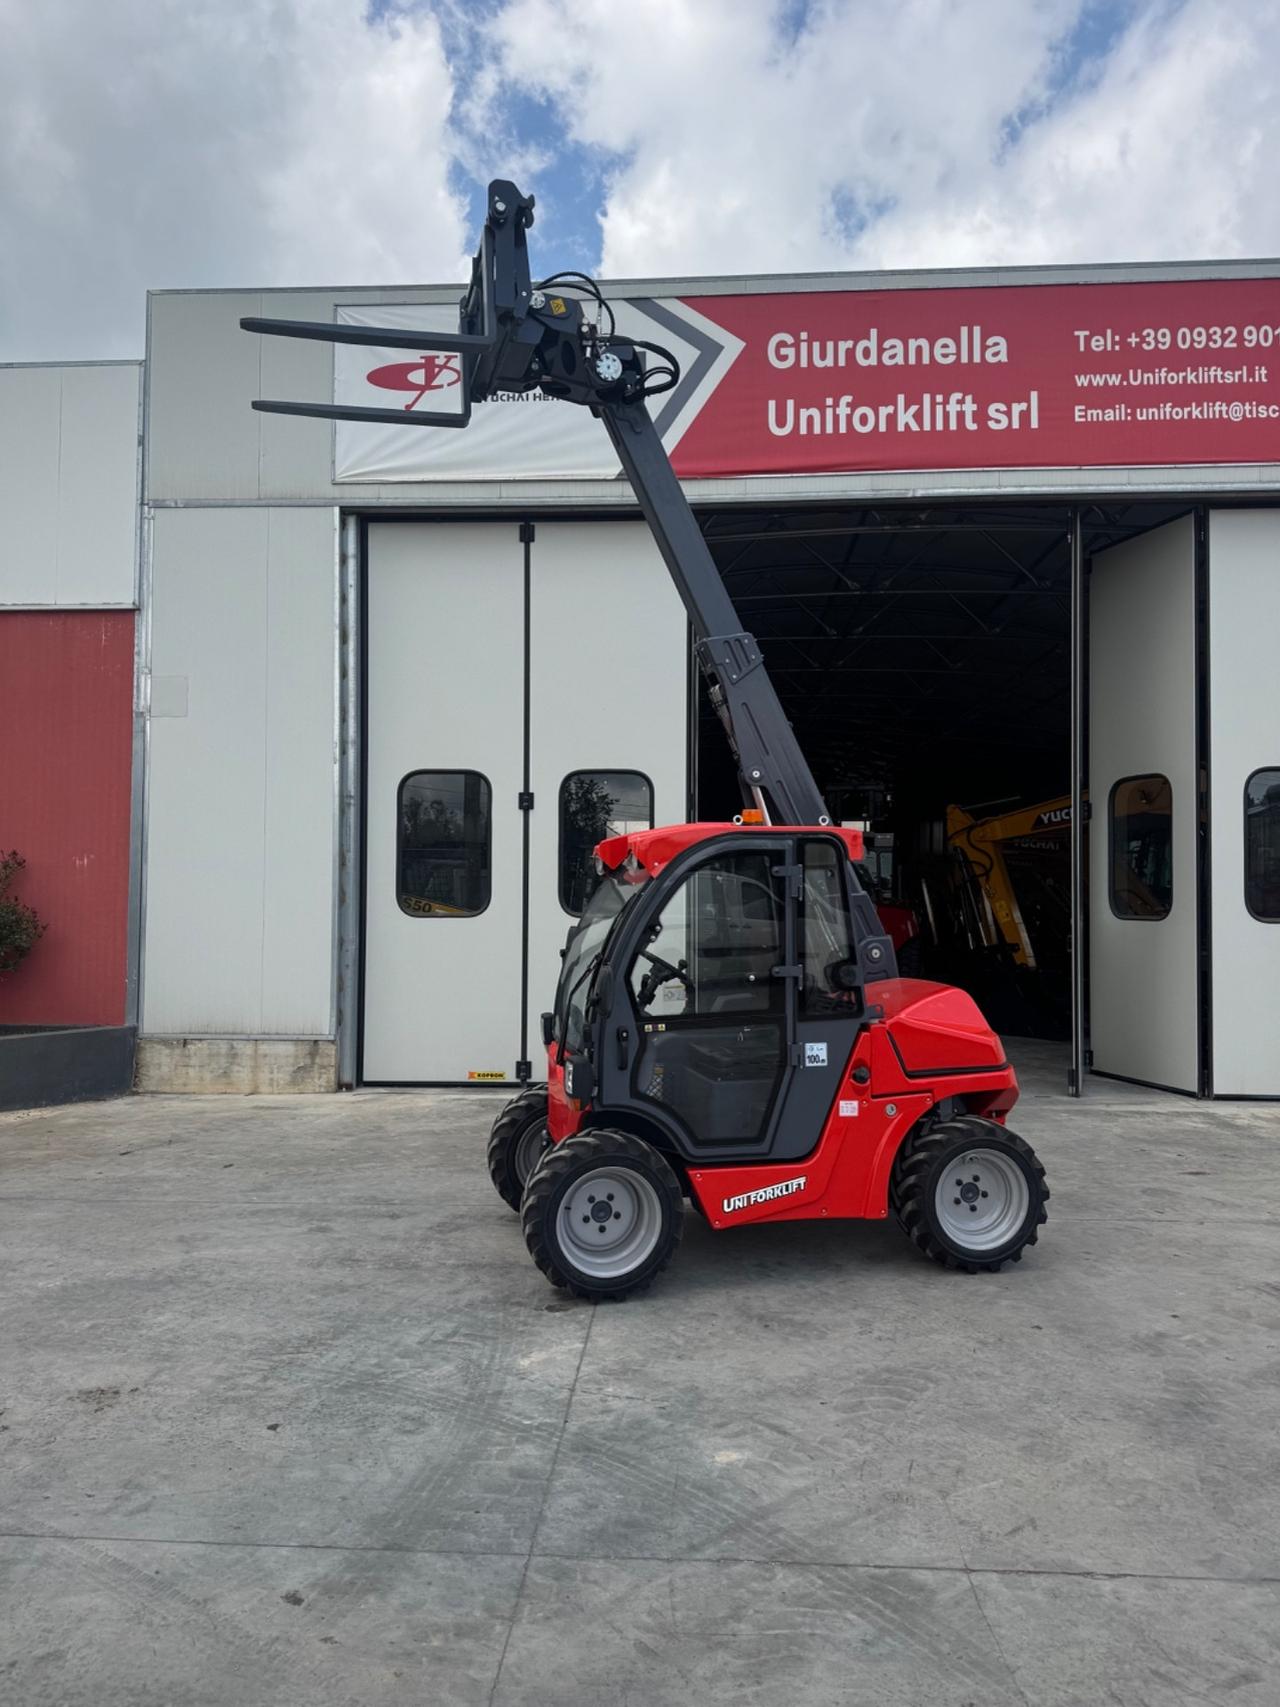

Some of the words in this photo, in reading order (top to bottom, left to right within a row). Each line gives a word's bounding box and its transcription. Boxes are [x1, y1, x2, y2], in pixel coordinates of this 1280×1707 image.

[767, 325, 1009, 369] Giurdanella
[1074, 329, 1120, 352] Tel:
[1127, 328, 1171, 350] +39
[1177, 326, 1238, 350] 0932
[1074, 365, 1268, 387] www.Uniforkliftsrl.it
[767, 393, 978, 437] Uniforklift
[987, 390, 1039, 430] srl
[1074, 403, 1132, 423] Email:
[1136, 401, 1280, 423] uniforklift@tisc
